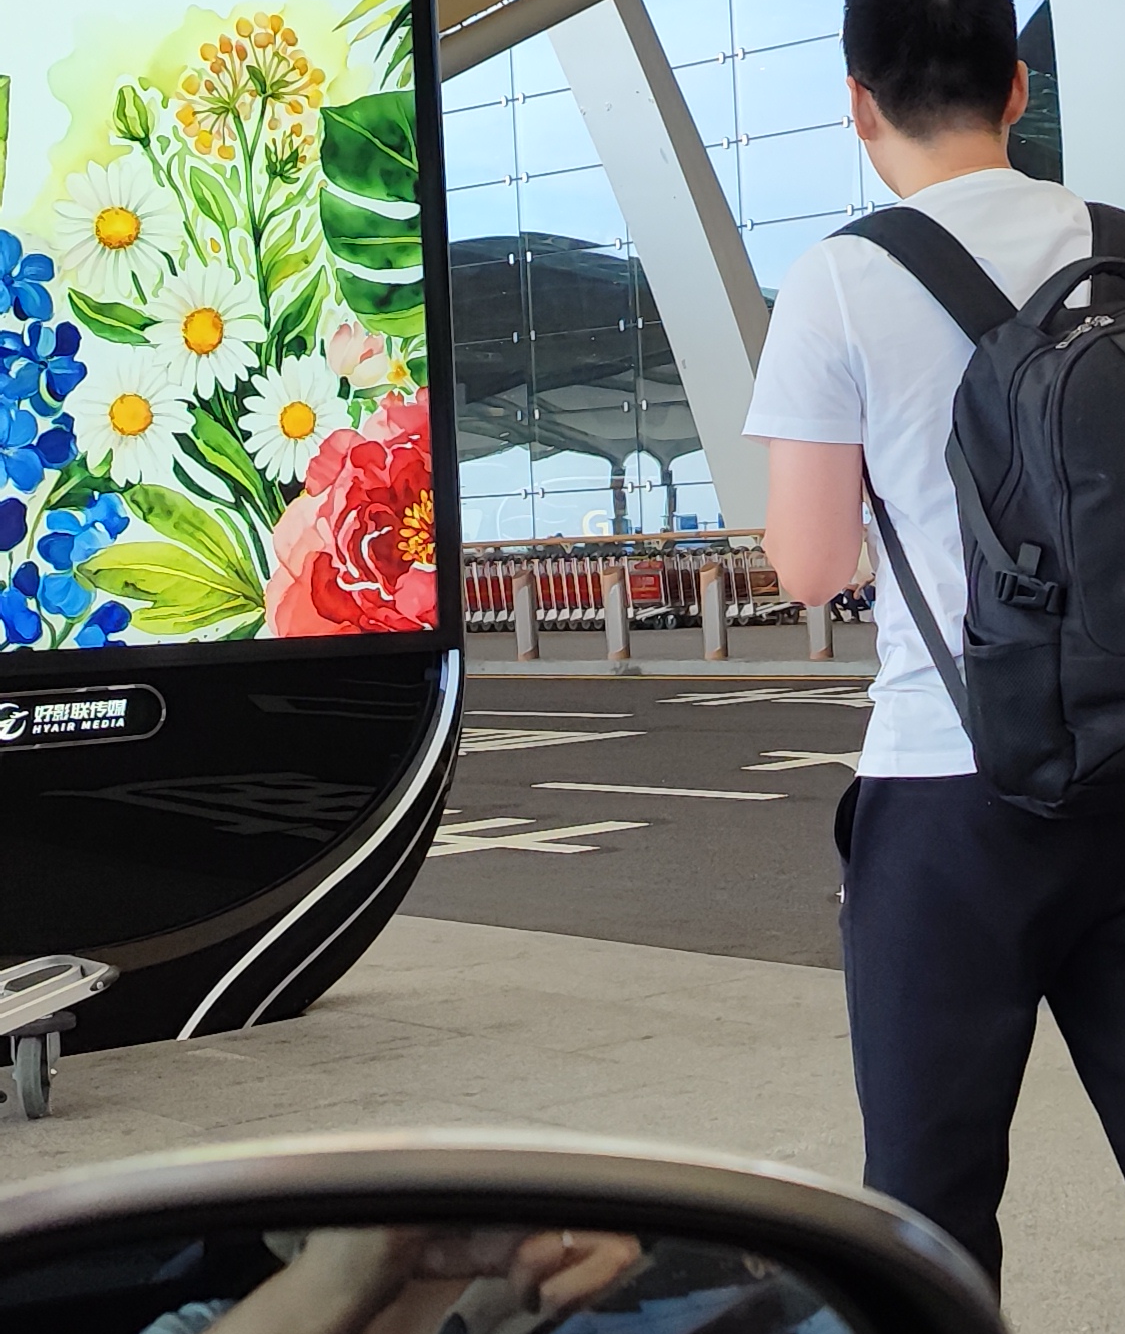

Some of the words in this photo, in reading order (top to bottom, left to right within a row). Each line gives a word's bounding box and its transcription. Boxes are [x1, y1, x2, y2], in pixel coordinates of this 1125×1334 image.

[582, 509, 609, 536] G
[32, 721, 76, 734] HYAIR
[81, 717, 125, 730] MEDIA
